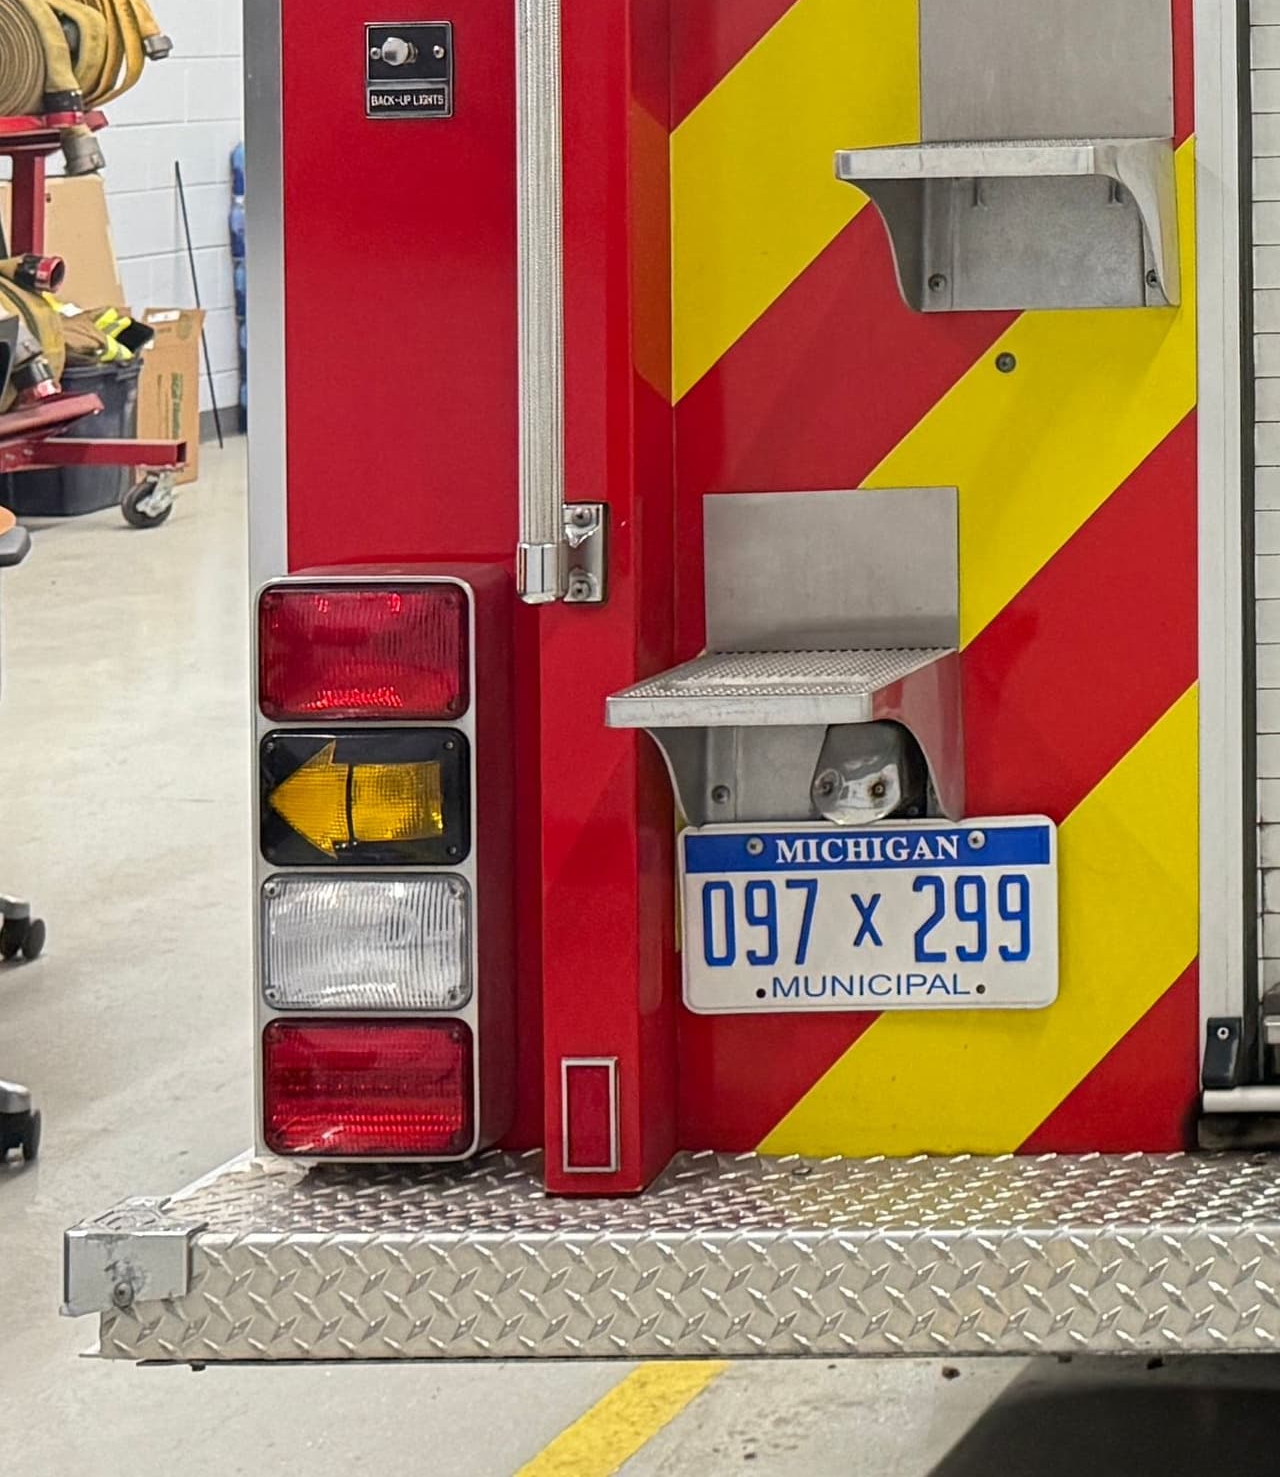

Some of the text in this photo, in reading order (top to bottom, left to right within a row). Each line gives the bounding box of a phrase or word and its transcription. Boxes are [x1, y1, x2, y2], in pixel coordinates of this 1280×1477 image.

[370, 94, 444, 107] BACK-UP LIGHTS
[775, 834, 959, 864] MICHIGAN
[701, 877, 819, 967] 097
[911, 873, 1031, 963] 299
[772, 973, 971, 999] MUNICIPAL
